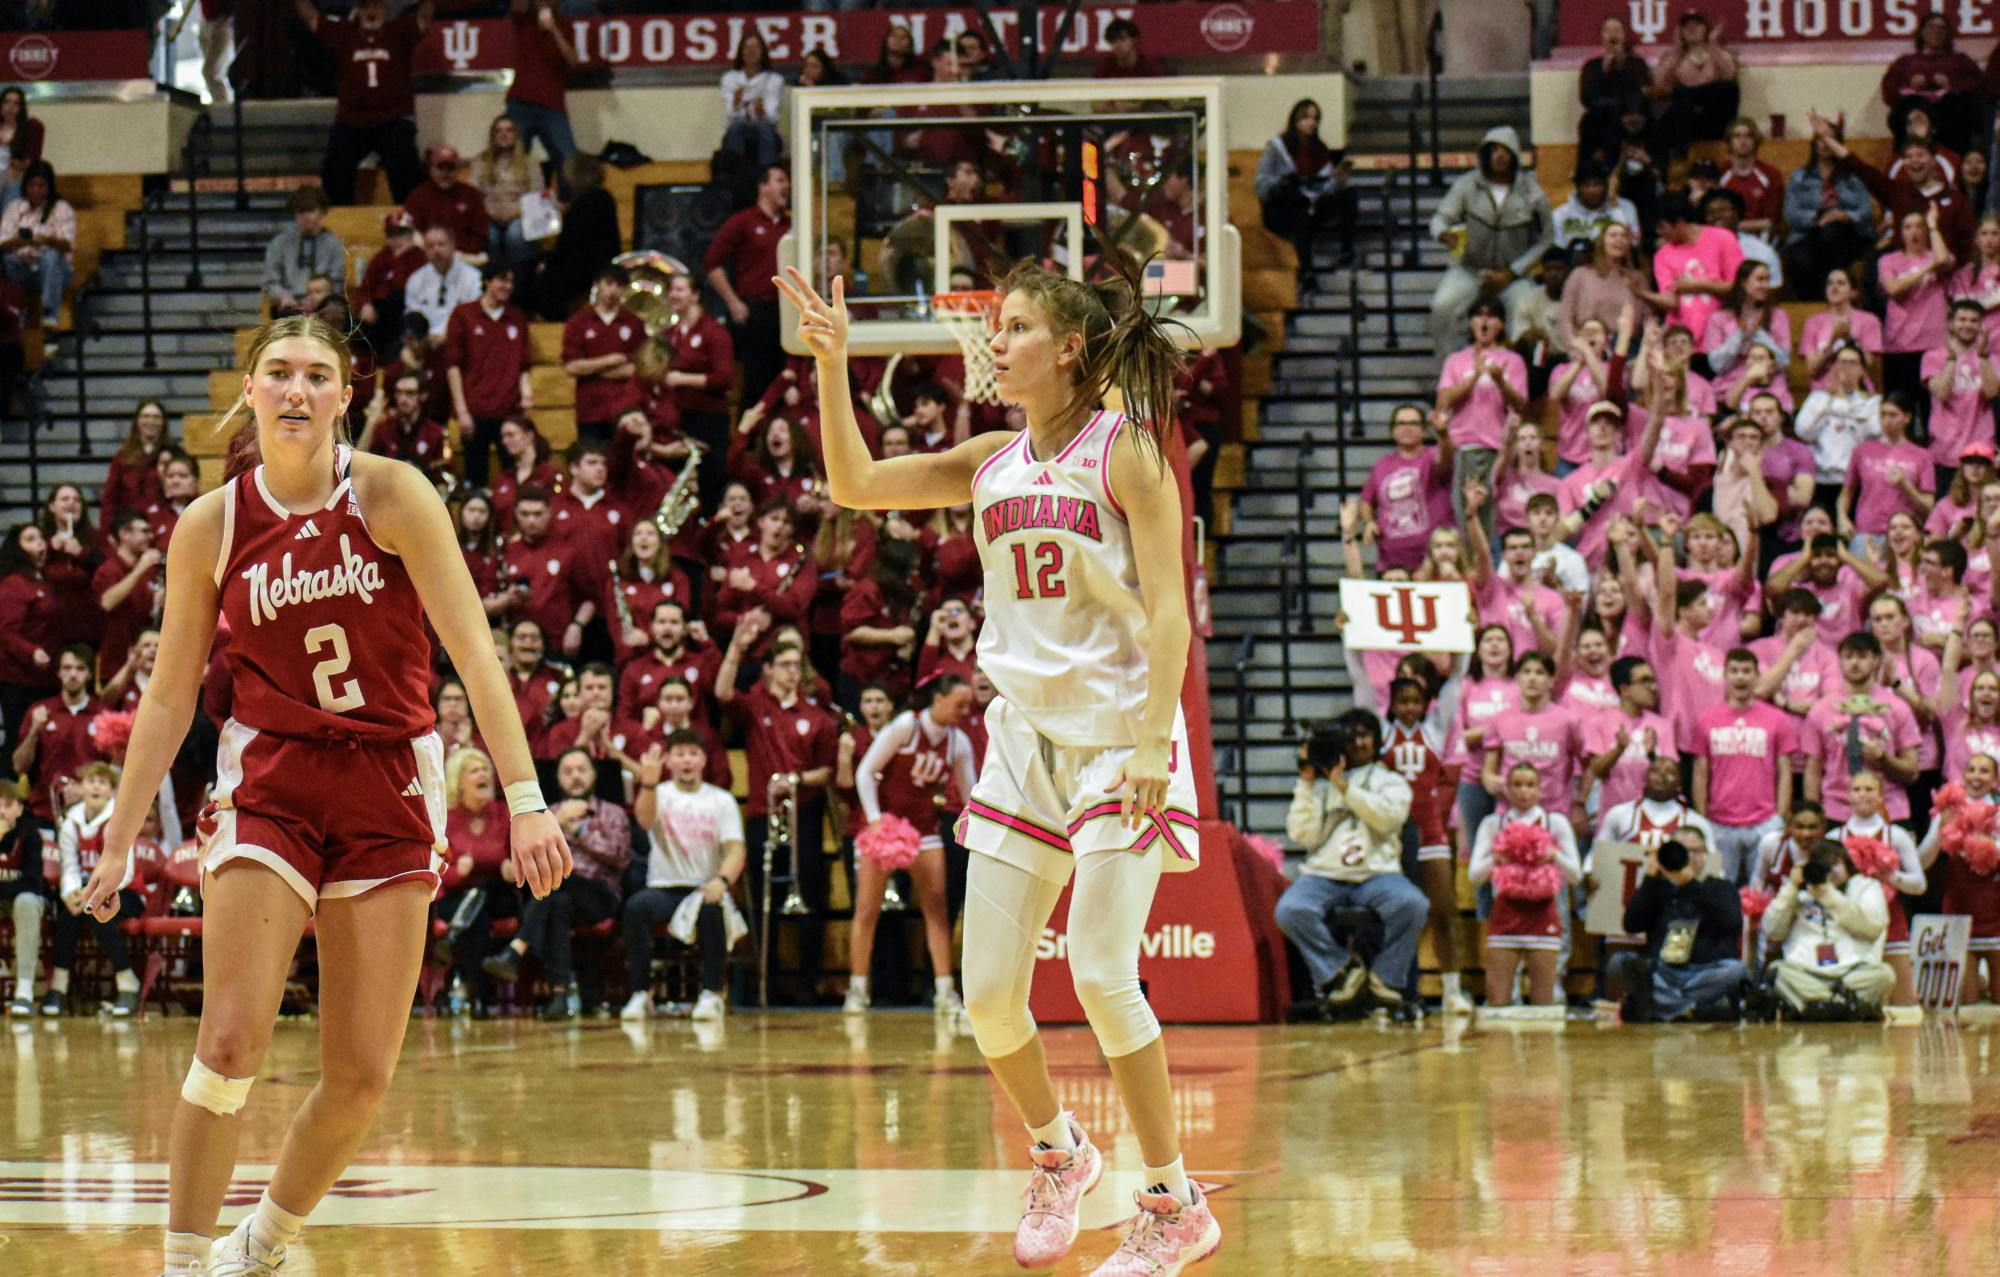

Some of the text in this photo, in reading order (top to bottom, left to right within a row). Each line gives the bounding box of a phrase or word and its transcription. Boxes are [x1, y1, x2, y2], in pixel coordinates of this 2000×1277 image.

[367, 61, 378, 88] 1
[981, 494, 1103, 545] INDIANA
[241, 533, 385, 627] Nebraska
[1010, 541, 1066, 599] 12
[1369, 586, 1440, 645] IU
[304, 622, 366, 714] 2
[1917, 921, 1949, 957] Get
